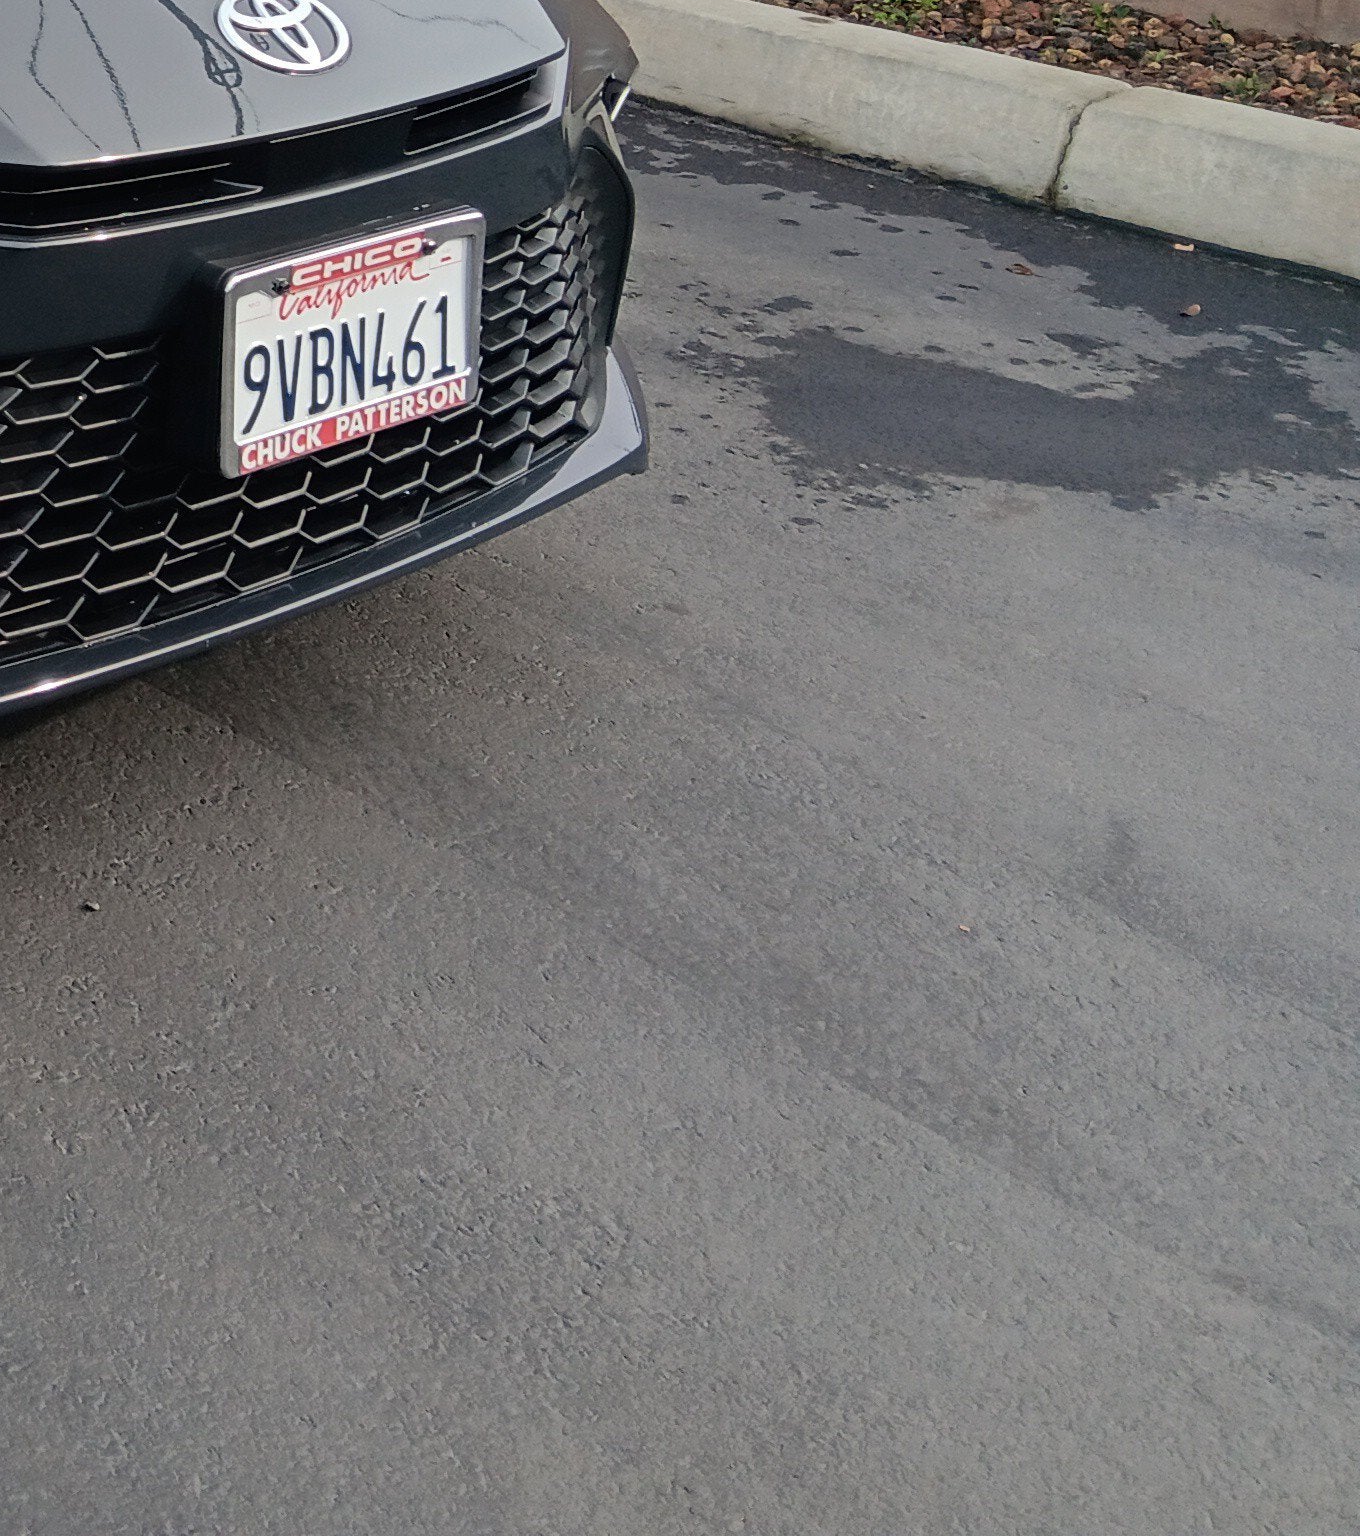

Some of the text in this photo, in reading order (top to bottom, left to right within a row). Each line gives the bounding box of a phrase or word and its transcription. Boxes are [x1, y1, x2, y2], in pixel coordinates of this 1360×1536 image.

[279, 261, 430, 321] California
[291, 236, 422, 287] CHICO
[242, 291, 455, 436] 9VBN461
[241, 378, 467, 471] CHUCK PATTERSON
